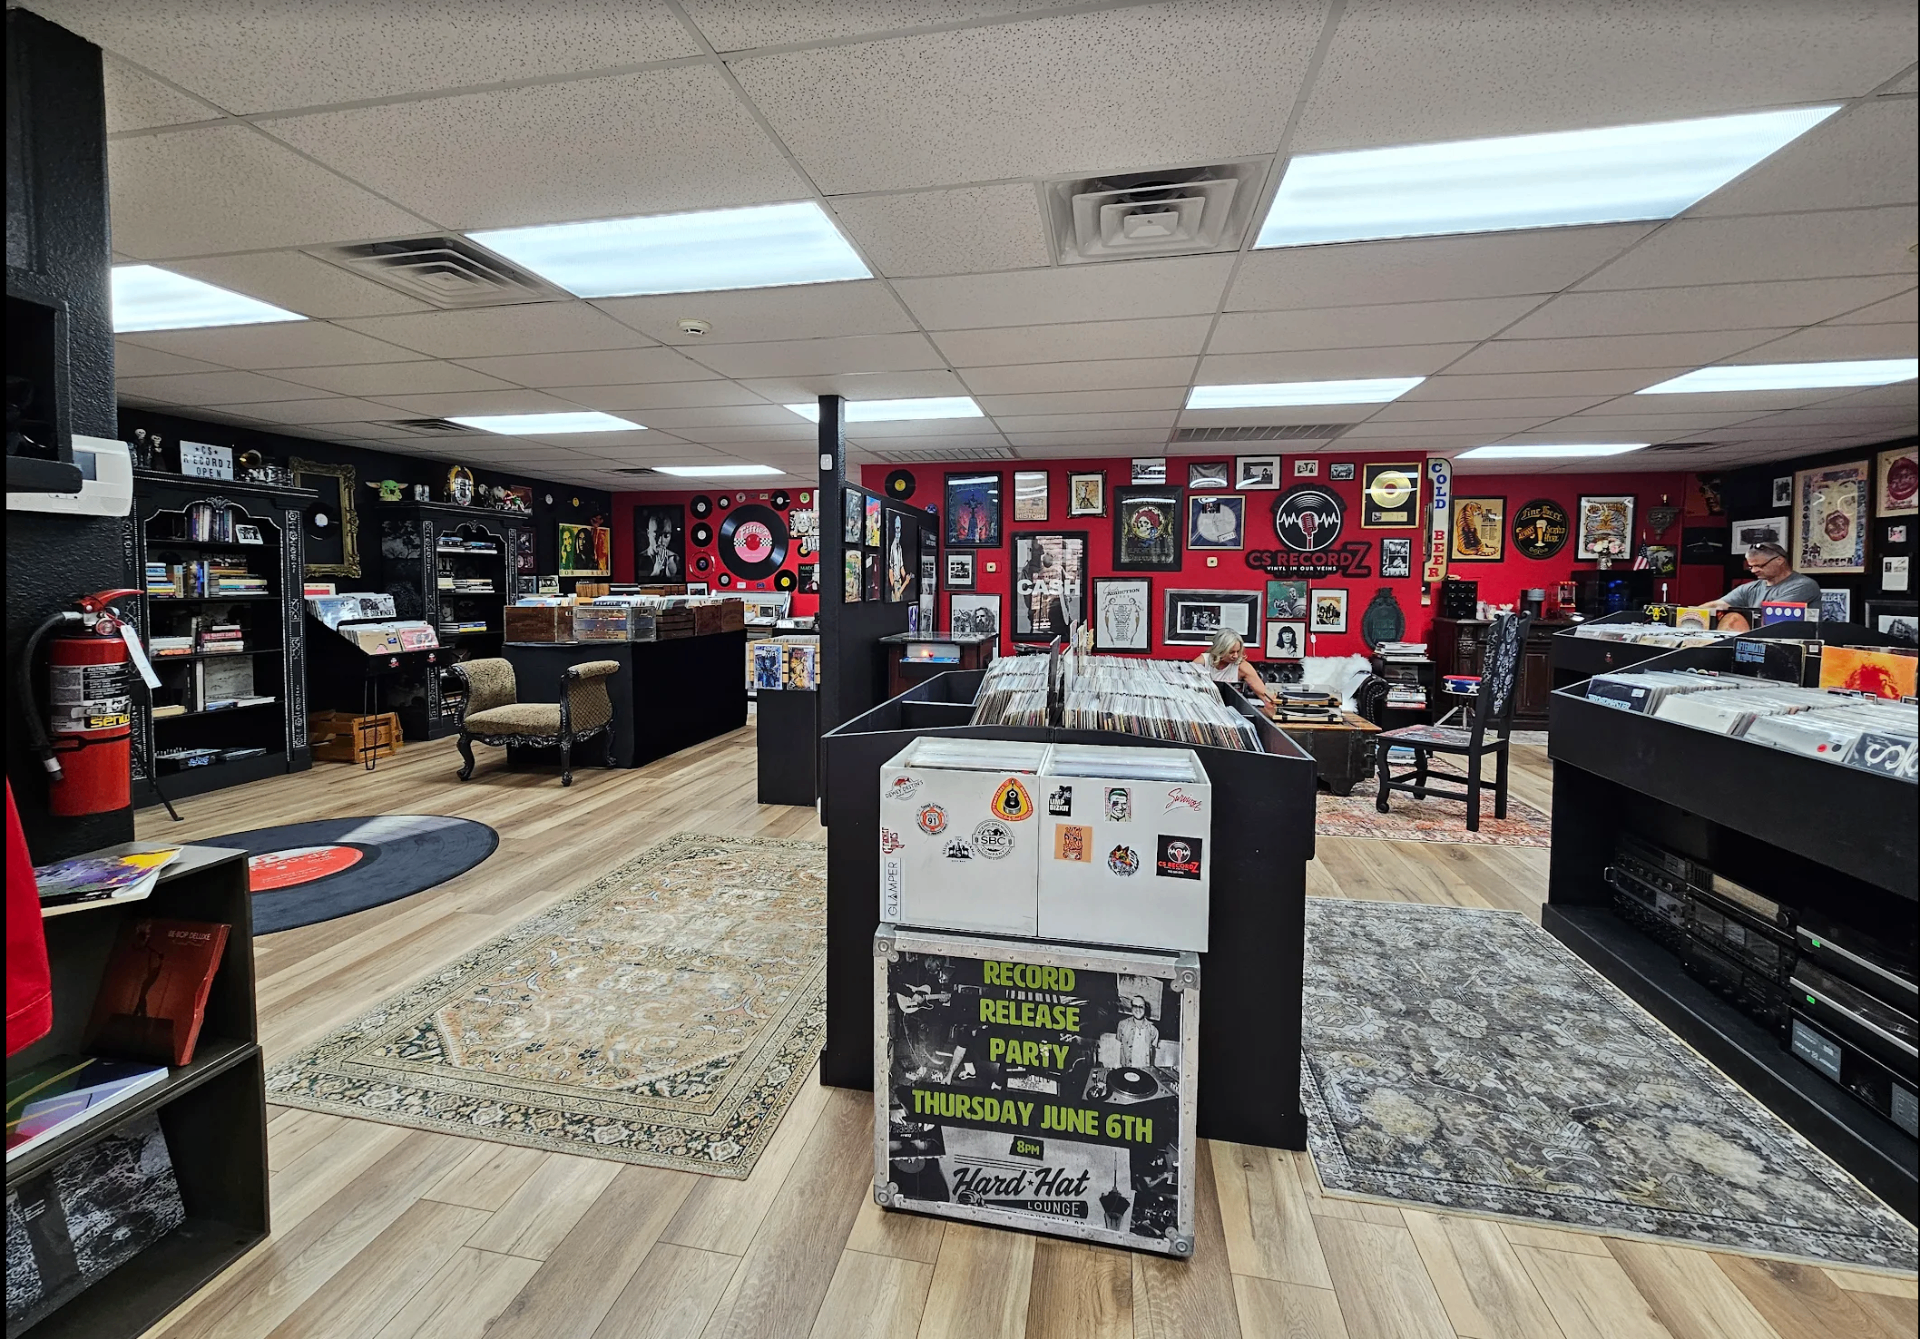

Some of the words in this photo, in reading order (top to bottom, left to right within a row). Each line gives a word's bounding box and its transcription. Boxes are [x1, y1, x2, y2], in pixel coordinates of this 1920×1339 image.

[196, 466, 222, 478] OPEN
[1431, 463, 1448, 510] COLD
[1249, 552, 1272, 566] CS
[1277, 544, 1369, 575] RECORDZ
[1427, 530, 1446, 578] BEER
[1017, 579, 1081, 596] CASH
[927, 817, 938, 825] 91
[1049, 804, 1070, 812] BIZKIT
[980, 835, 1006, 845] SBC
[1167, 861, 1200, 874] RECORDZ
[887, 861, 898, 916] GLAMPER
[983, 960, 1076, 993] RECORD
[979, 998, 1080, 1032] RELEASE
[989, 1037, 1070, 1070] PARTY
[911, 1089, 1035, 1127] THURSDAY
[1040, 1105, 1099, 1136] JUNE
[1105, 1114, 1153, 1144] 6TH
[1016, 1140, 1040, 1156] 8PM
[952, 1167, 1028, 1197] Hard
[1032, 1167, 1091, 1197] Hat
[1027, 1201, 1081, 1217] LOUNGE
